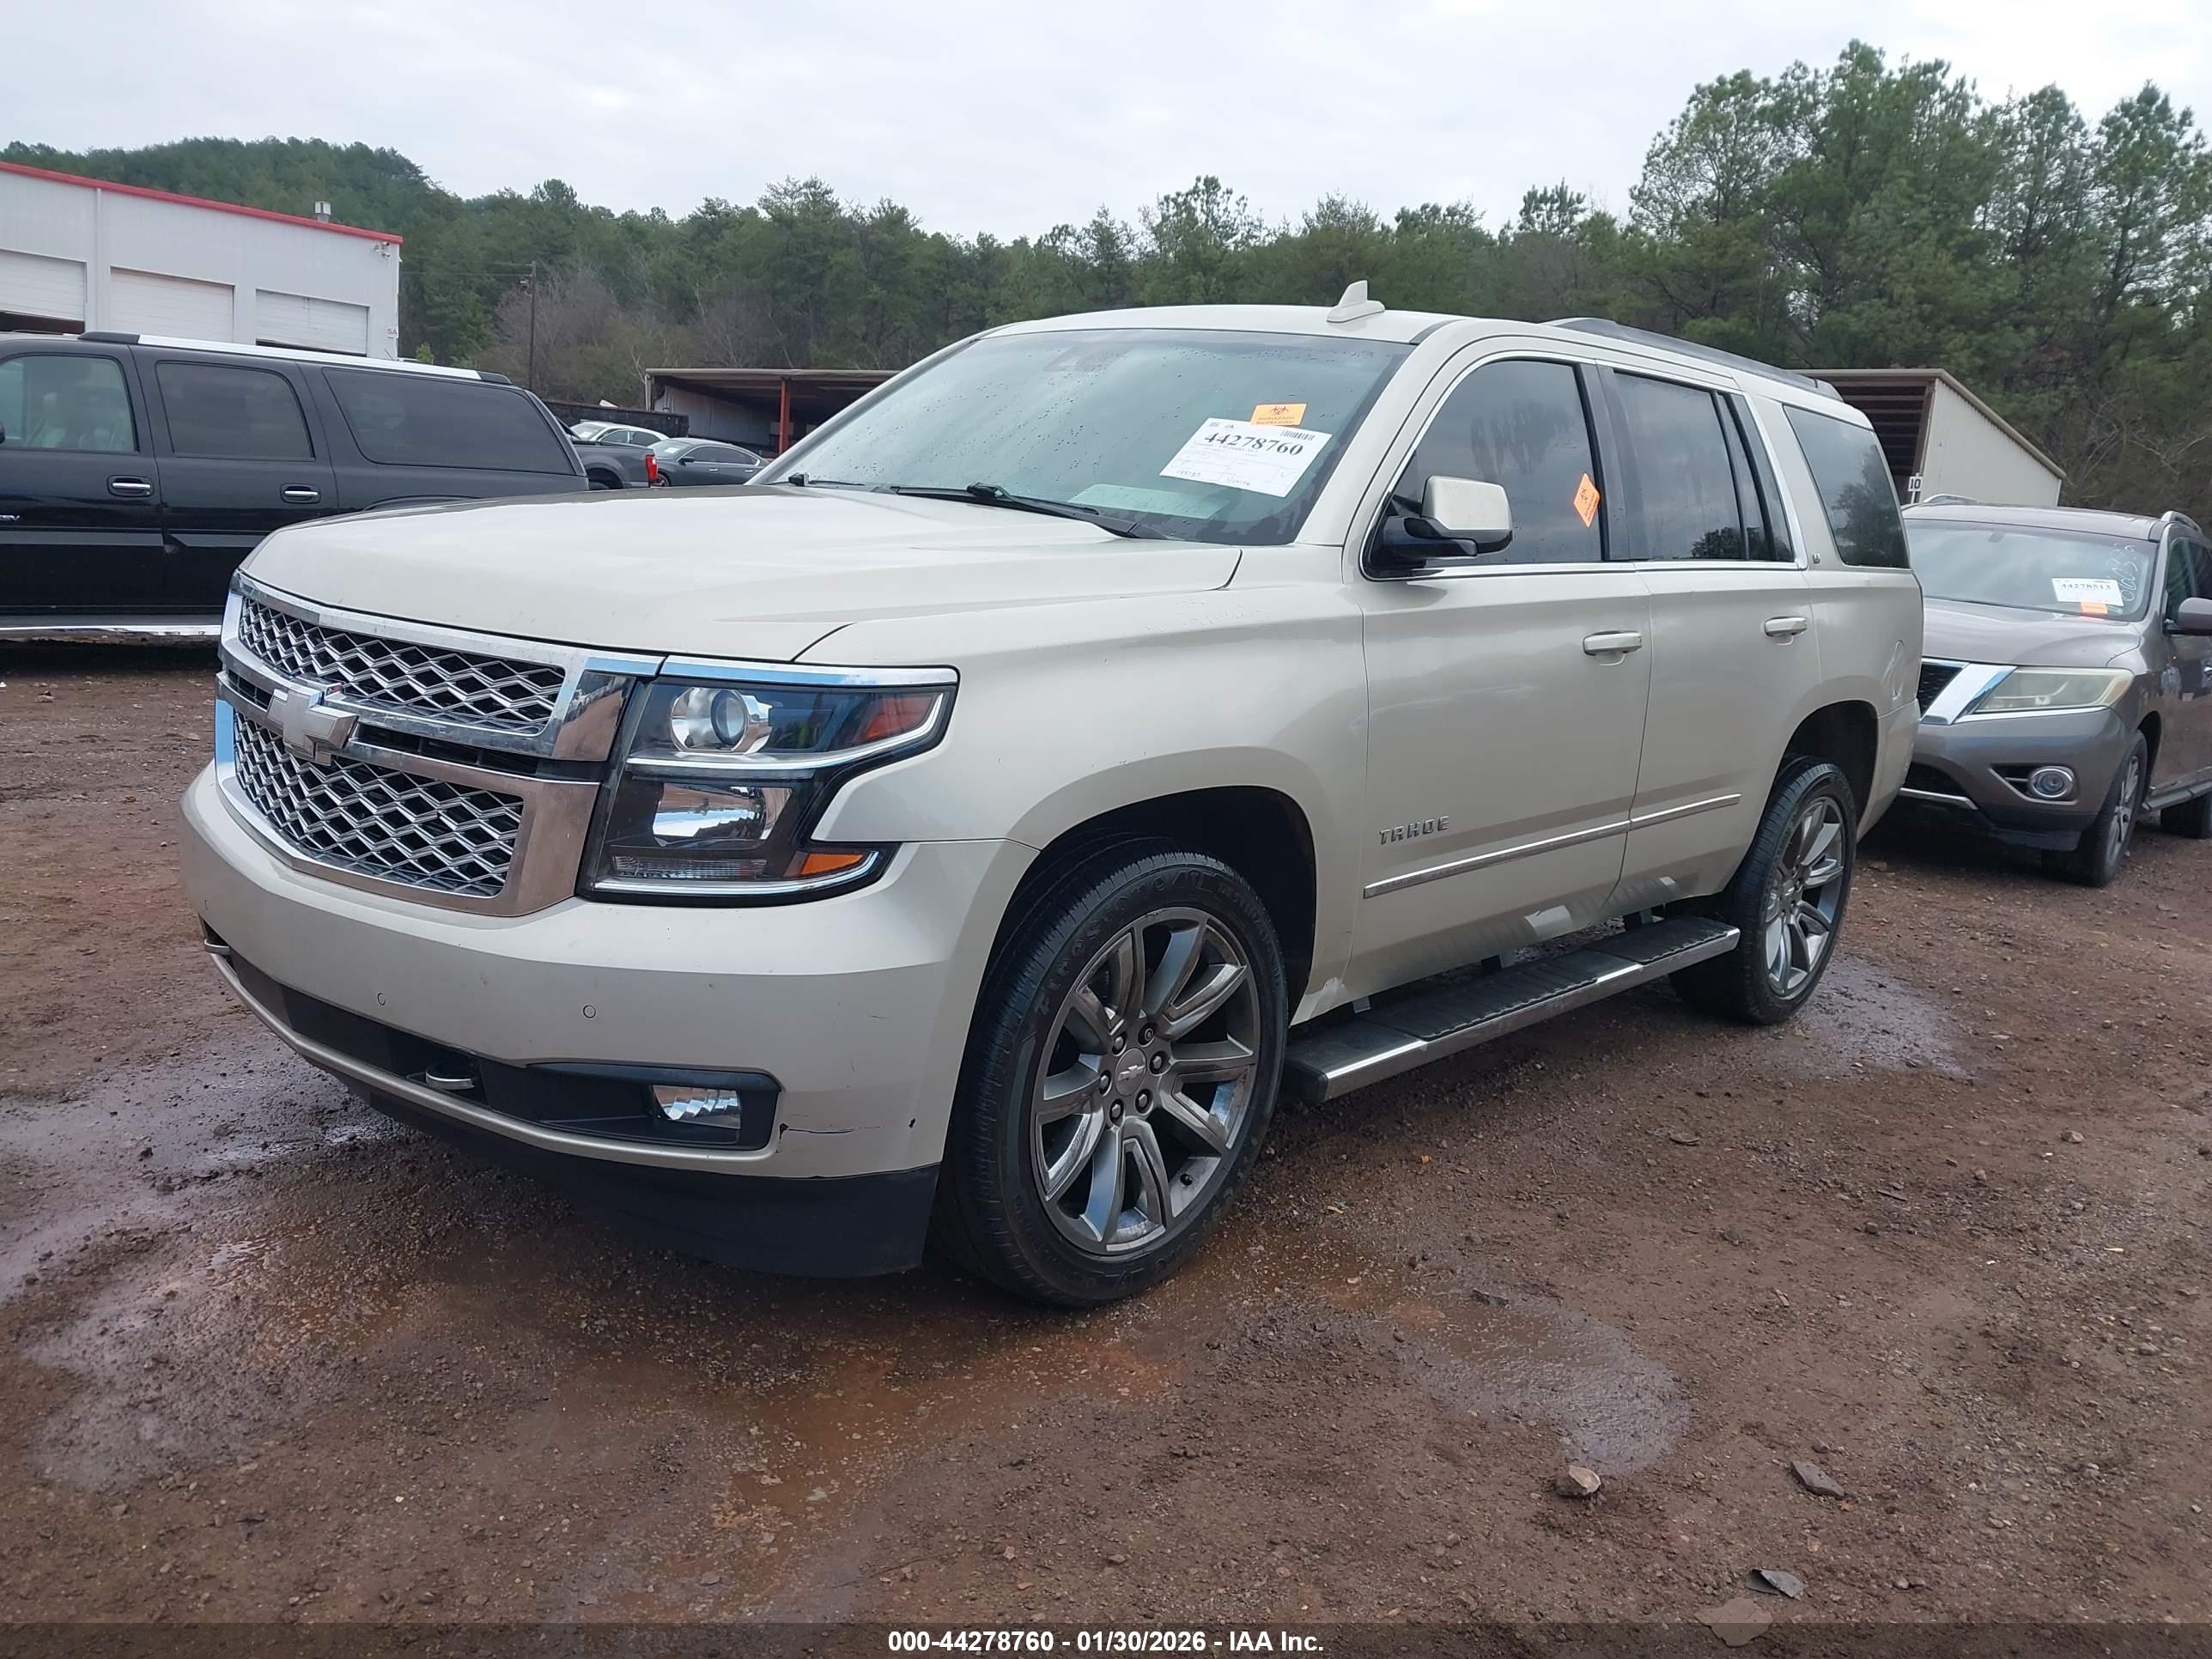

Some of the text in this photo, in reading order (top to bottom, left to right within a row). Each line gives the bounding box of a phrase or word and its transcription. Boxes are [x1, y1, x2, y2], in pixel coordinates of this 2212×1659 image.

[1204, 432, 1304, 456] 44278760
[1910, 478, 1921, 489] 10
[1378, 815, 1449, 845] TAHOE
